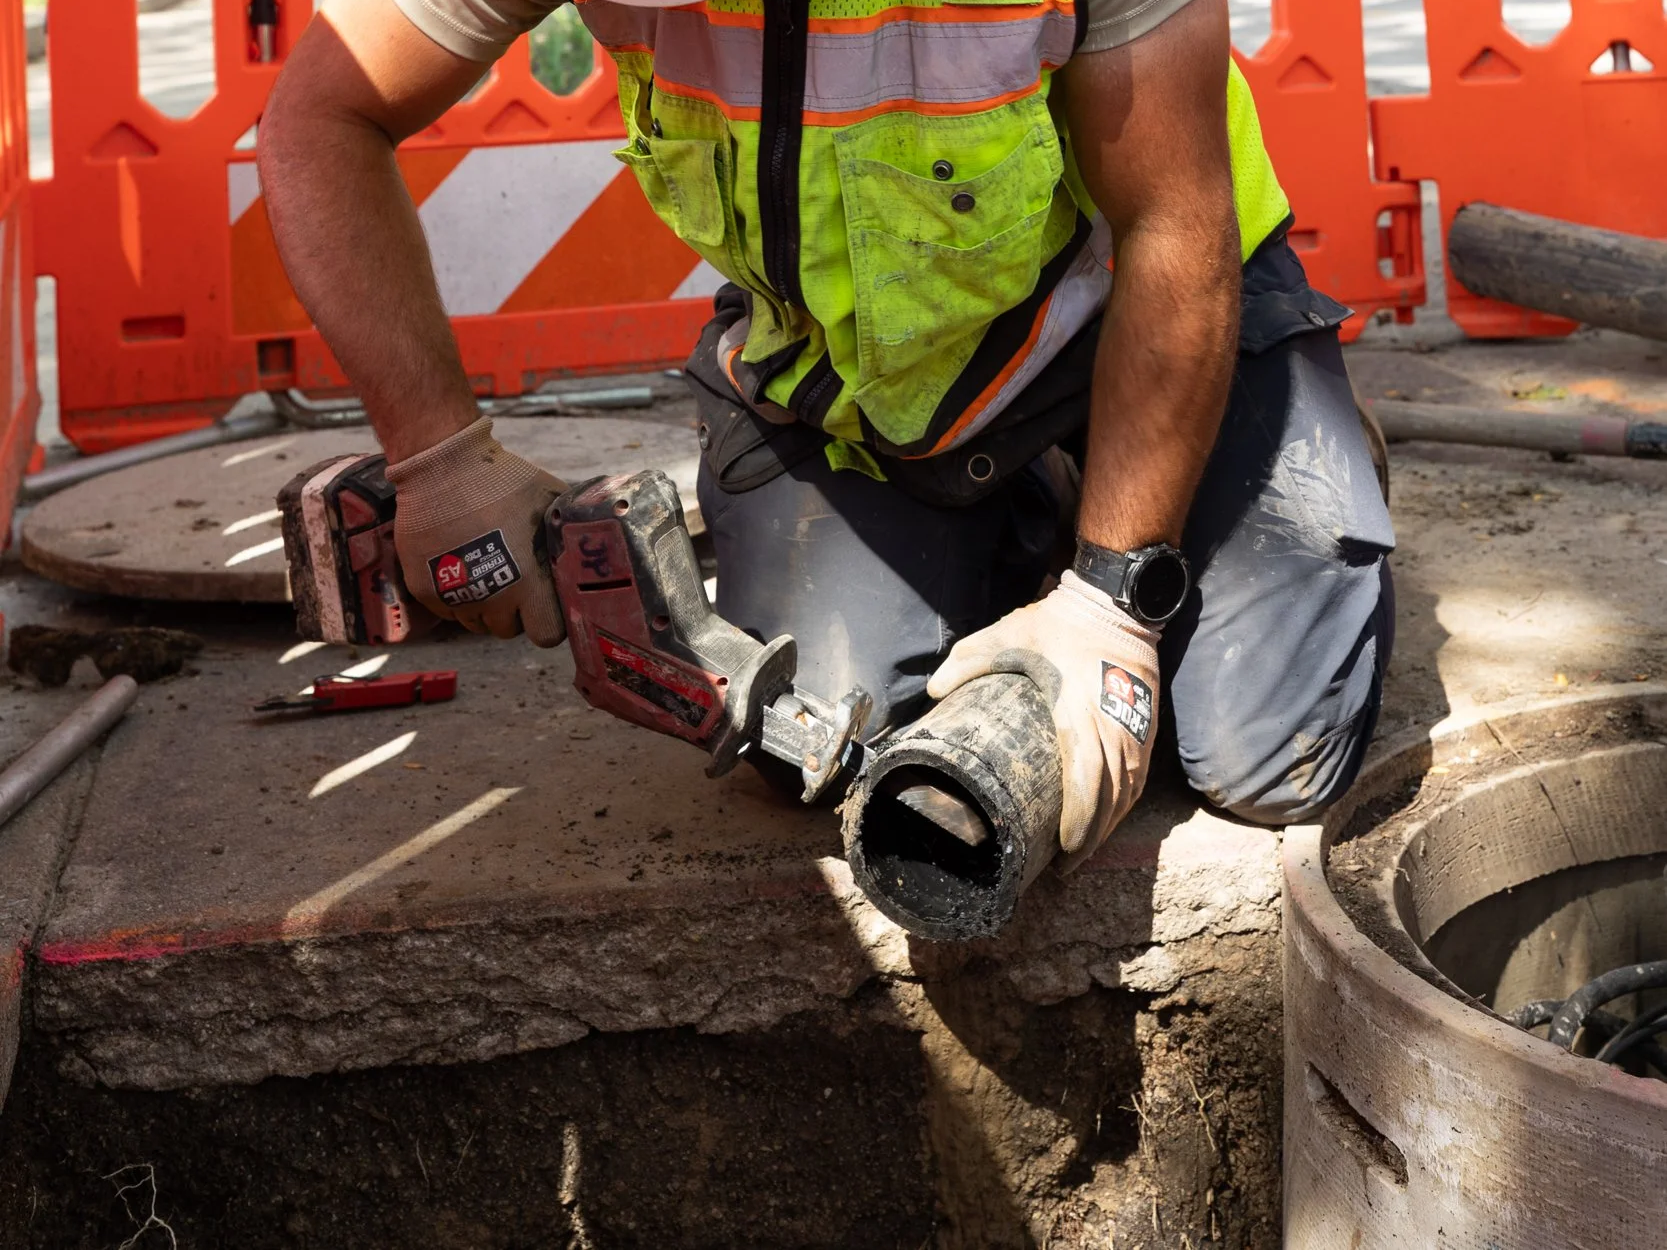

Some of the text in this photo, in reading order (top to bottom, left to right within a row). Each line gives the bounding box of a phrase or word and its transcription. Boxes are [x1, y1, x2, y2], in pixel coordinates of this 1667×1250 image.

[486, 542, 495, 552] 8
[439, 561, 460, 583] A5
[443, 564, 514, 606] D-ROC
